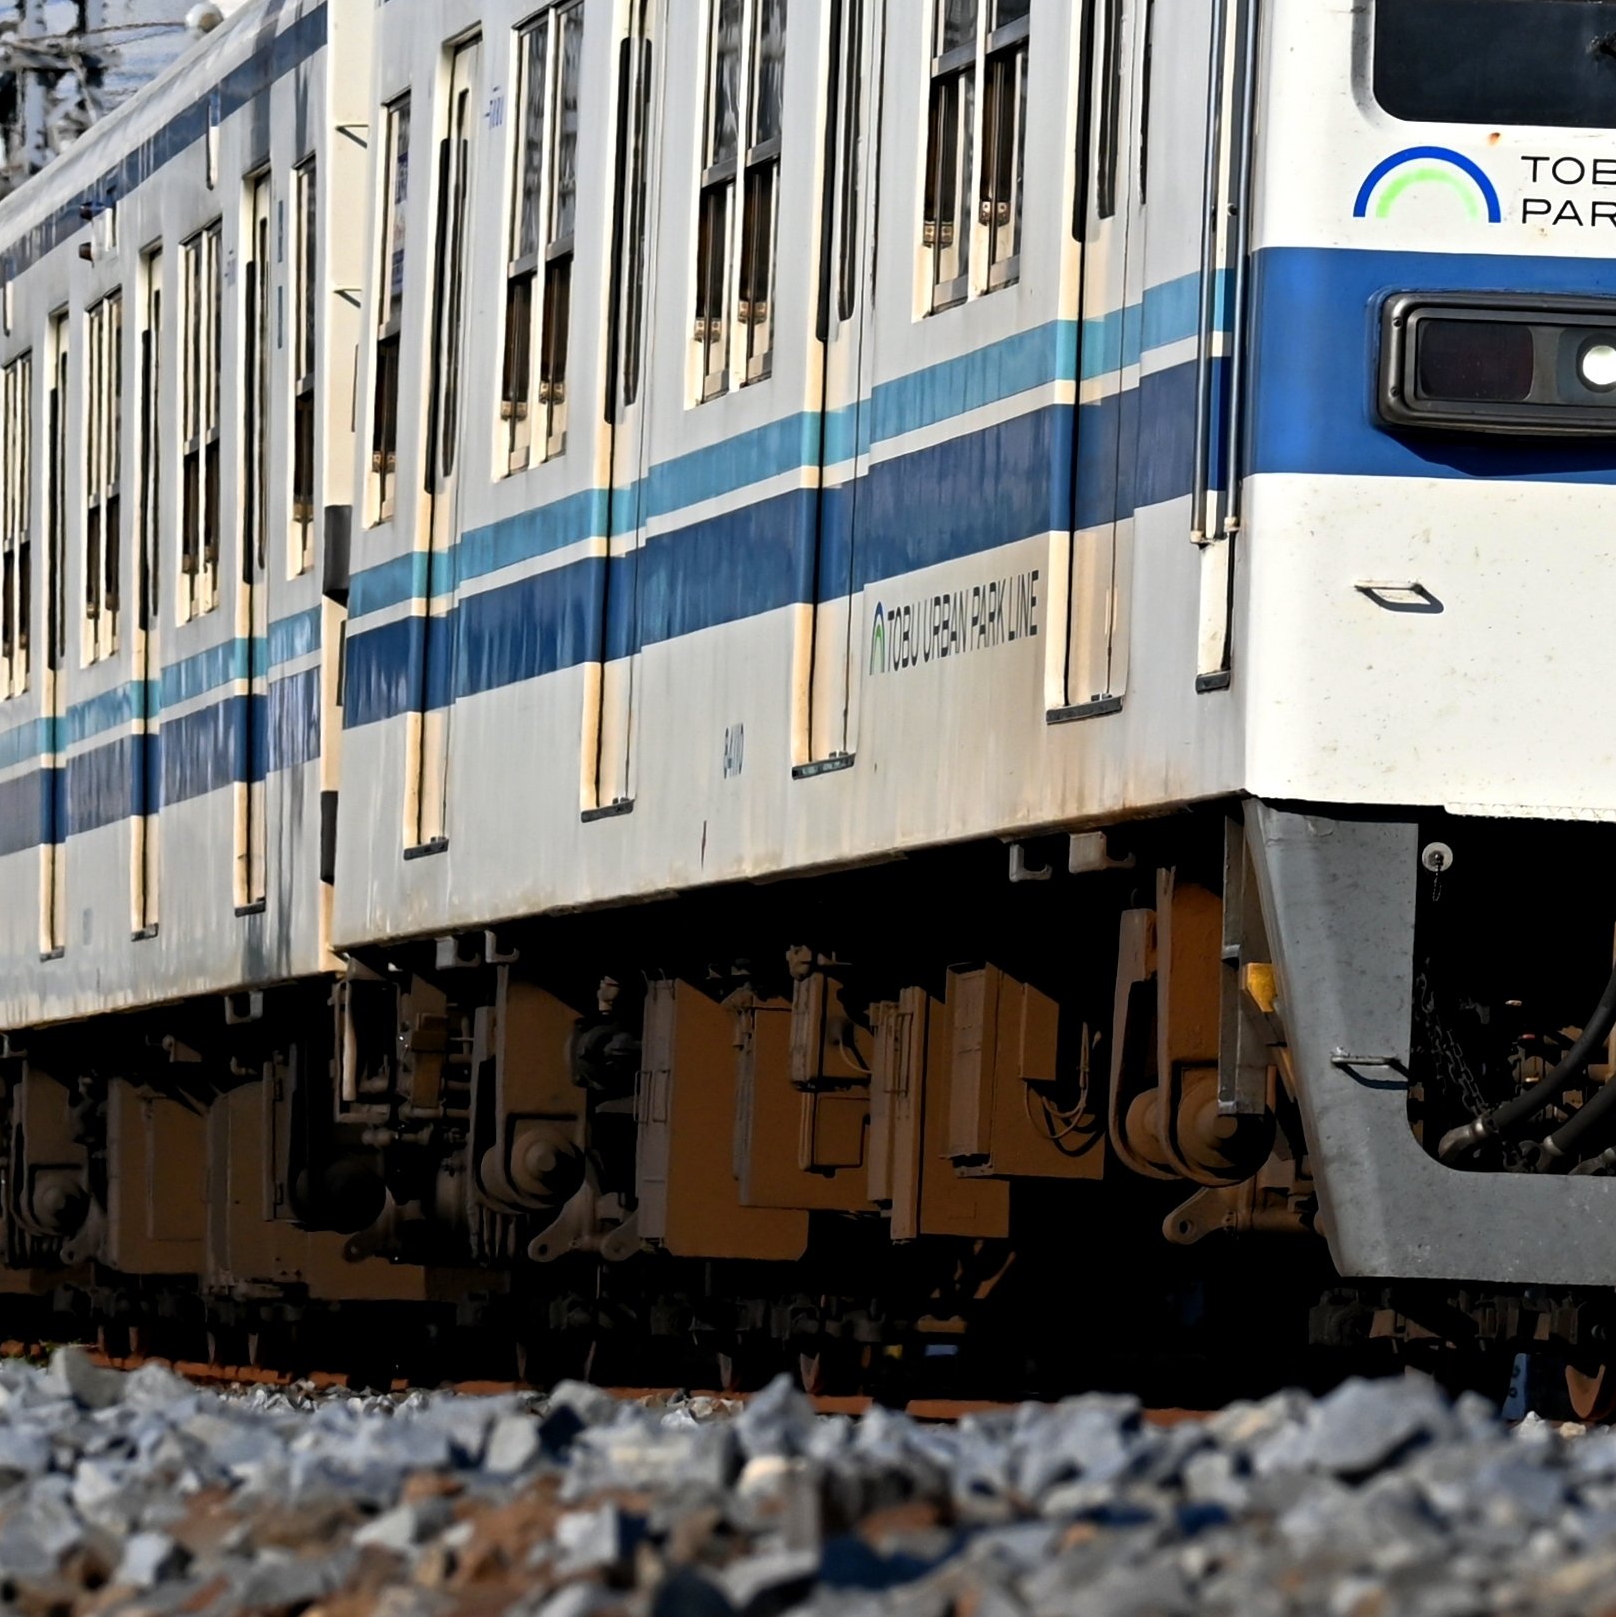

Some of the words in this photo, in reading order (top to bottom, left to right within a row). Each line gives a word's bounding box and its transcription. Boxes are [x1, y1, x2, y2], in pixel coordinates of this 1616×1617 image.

[887, 601, 920, 672] TOBU
[923, 589, 969, 663] URBAN
[970, 578, 1006, 651] PARK
[1008, 569, 1039, 641] LINE
